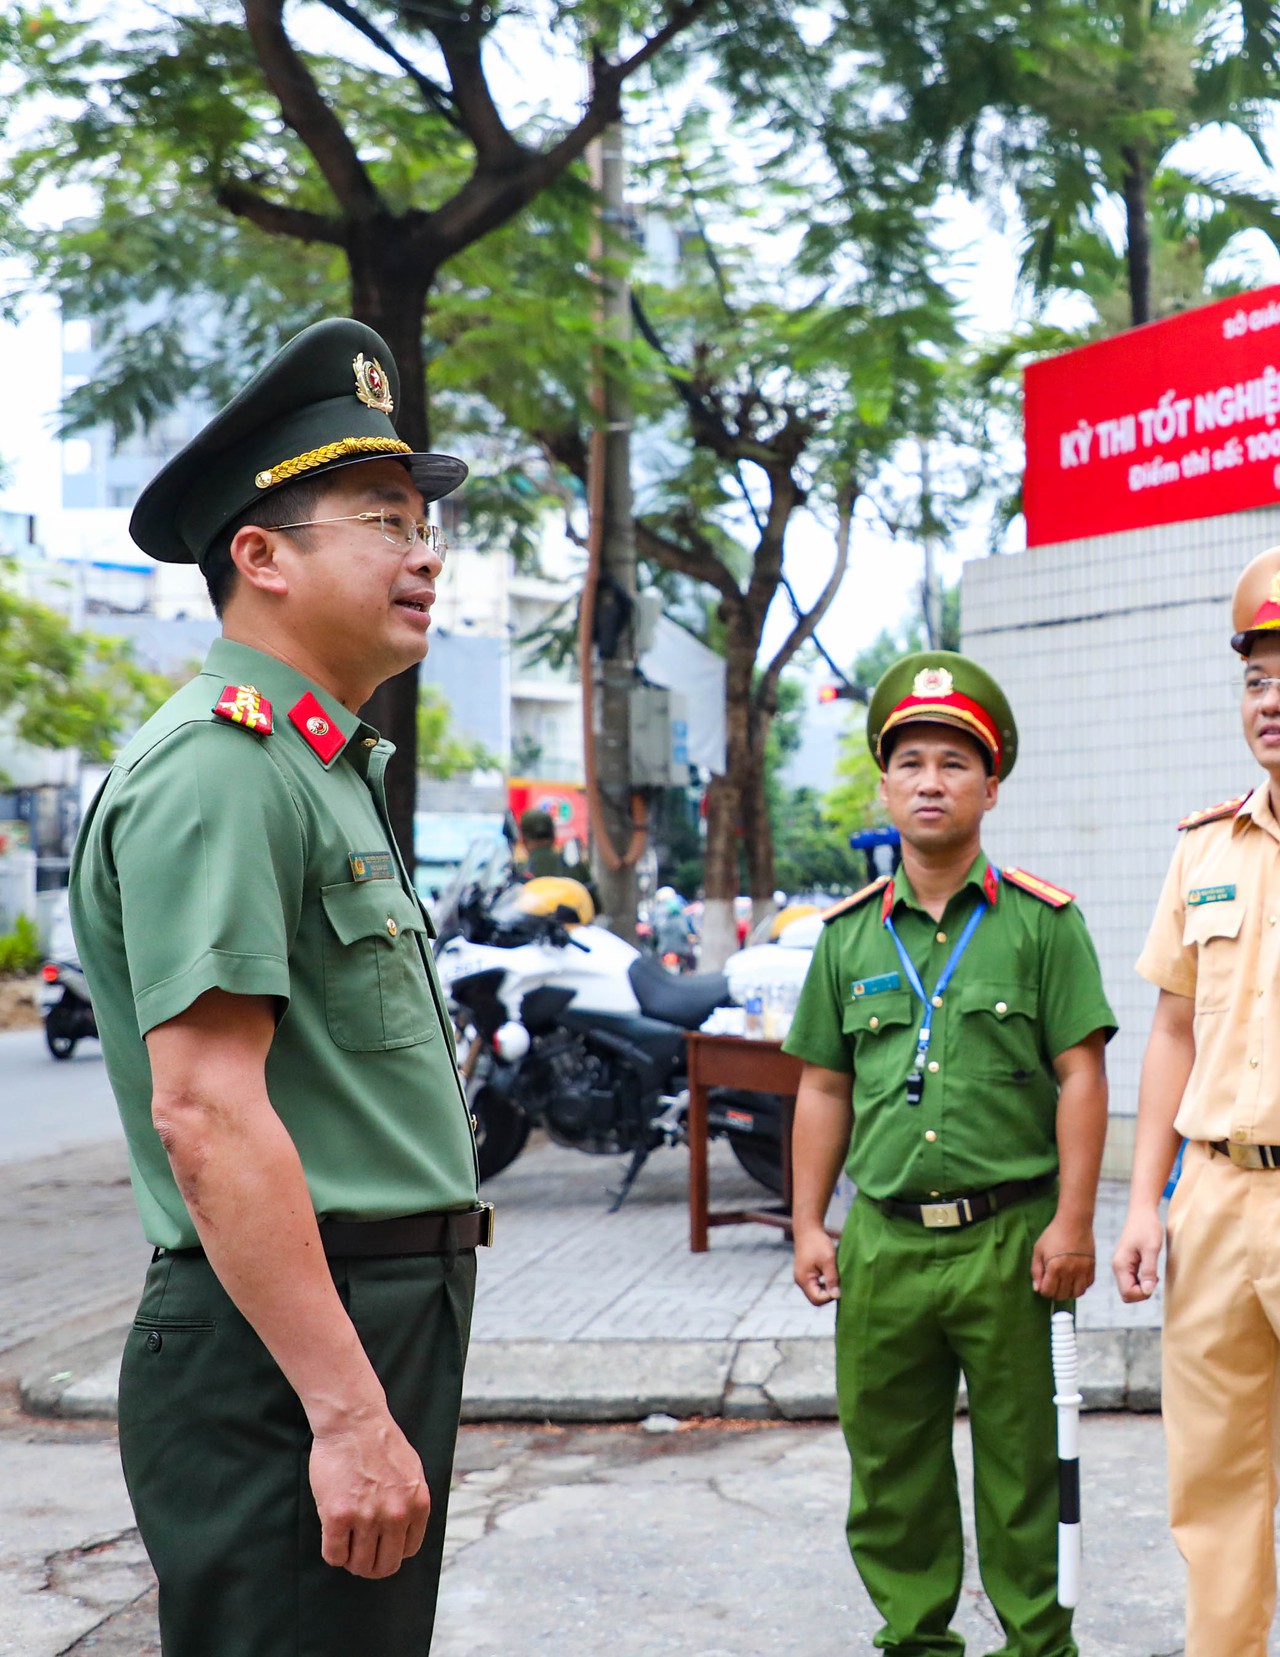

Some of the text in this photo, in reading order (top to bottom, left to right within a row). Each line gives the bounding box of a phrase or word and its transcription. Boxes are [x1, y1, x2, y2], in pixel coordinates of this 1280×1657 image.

[1060, 418, 1094, 469] KỲ
[1095, 414, 1137, 459] THI
[1138, 388, 1192, 448] TỐT
[1128, 454, 1180, 492] Điểm
[1181, 446, 1210, 479] thi
[1211, 436, 1244, 471] số:
